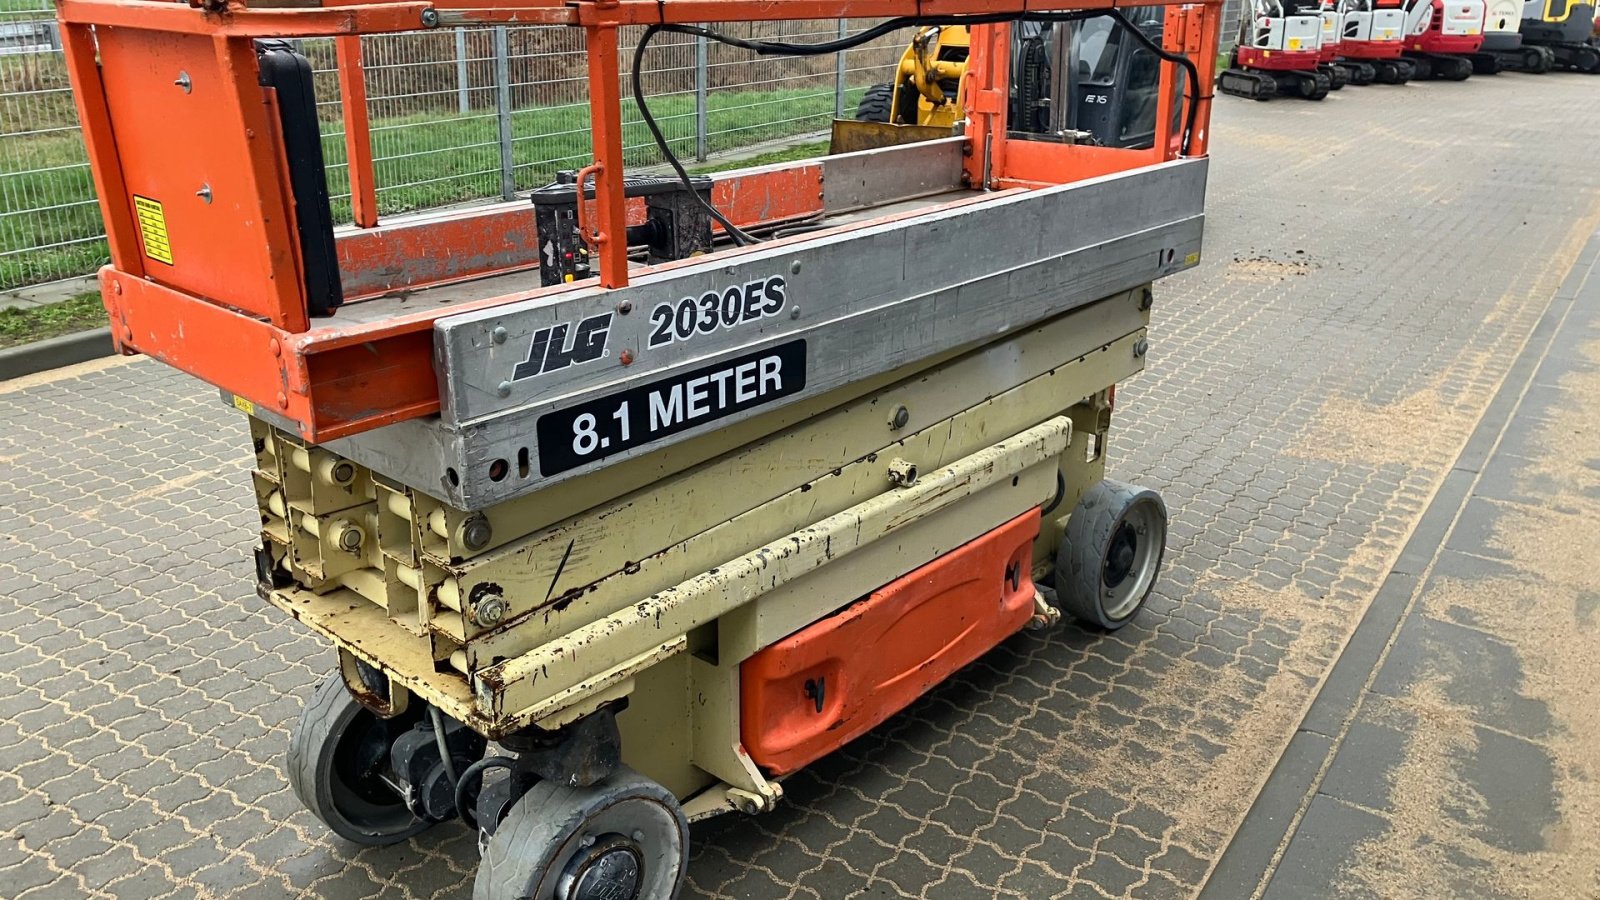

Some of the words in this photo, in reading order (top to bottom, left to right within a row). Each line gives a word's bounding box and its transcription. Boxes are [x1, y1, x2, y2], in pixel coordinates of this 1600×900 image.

[511, 311, 615, 382] JLG
[648, 274, 787, 349] 2030ES
[572, 400, 630, 456] 8.1
[648, 355, 783, 432] METER
